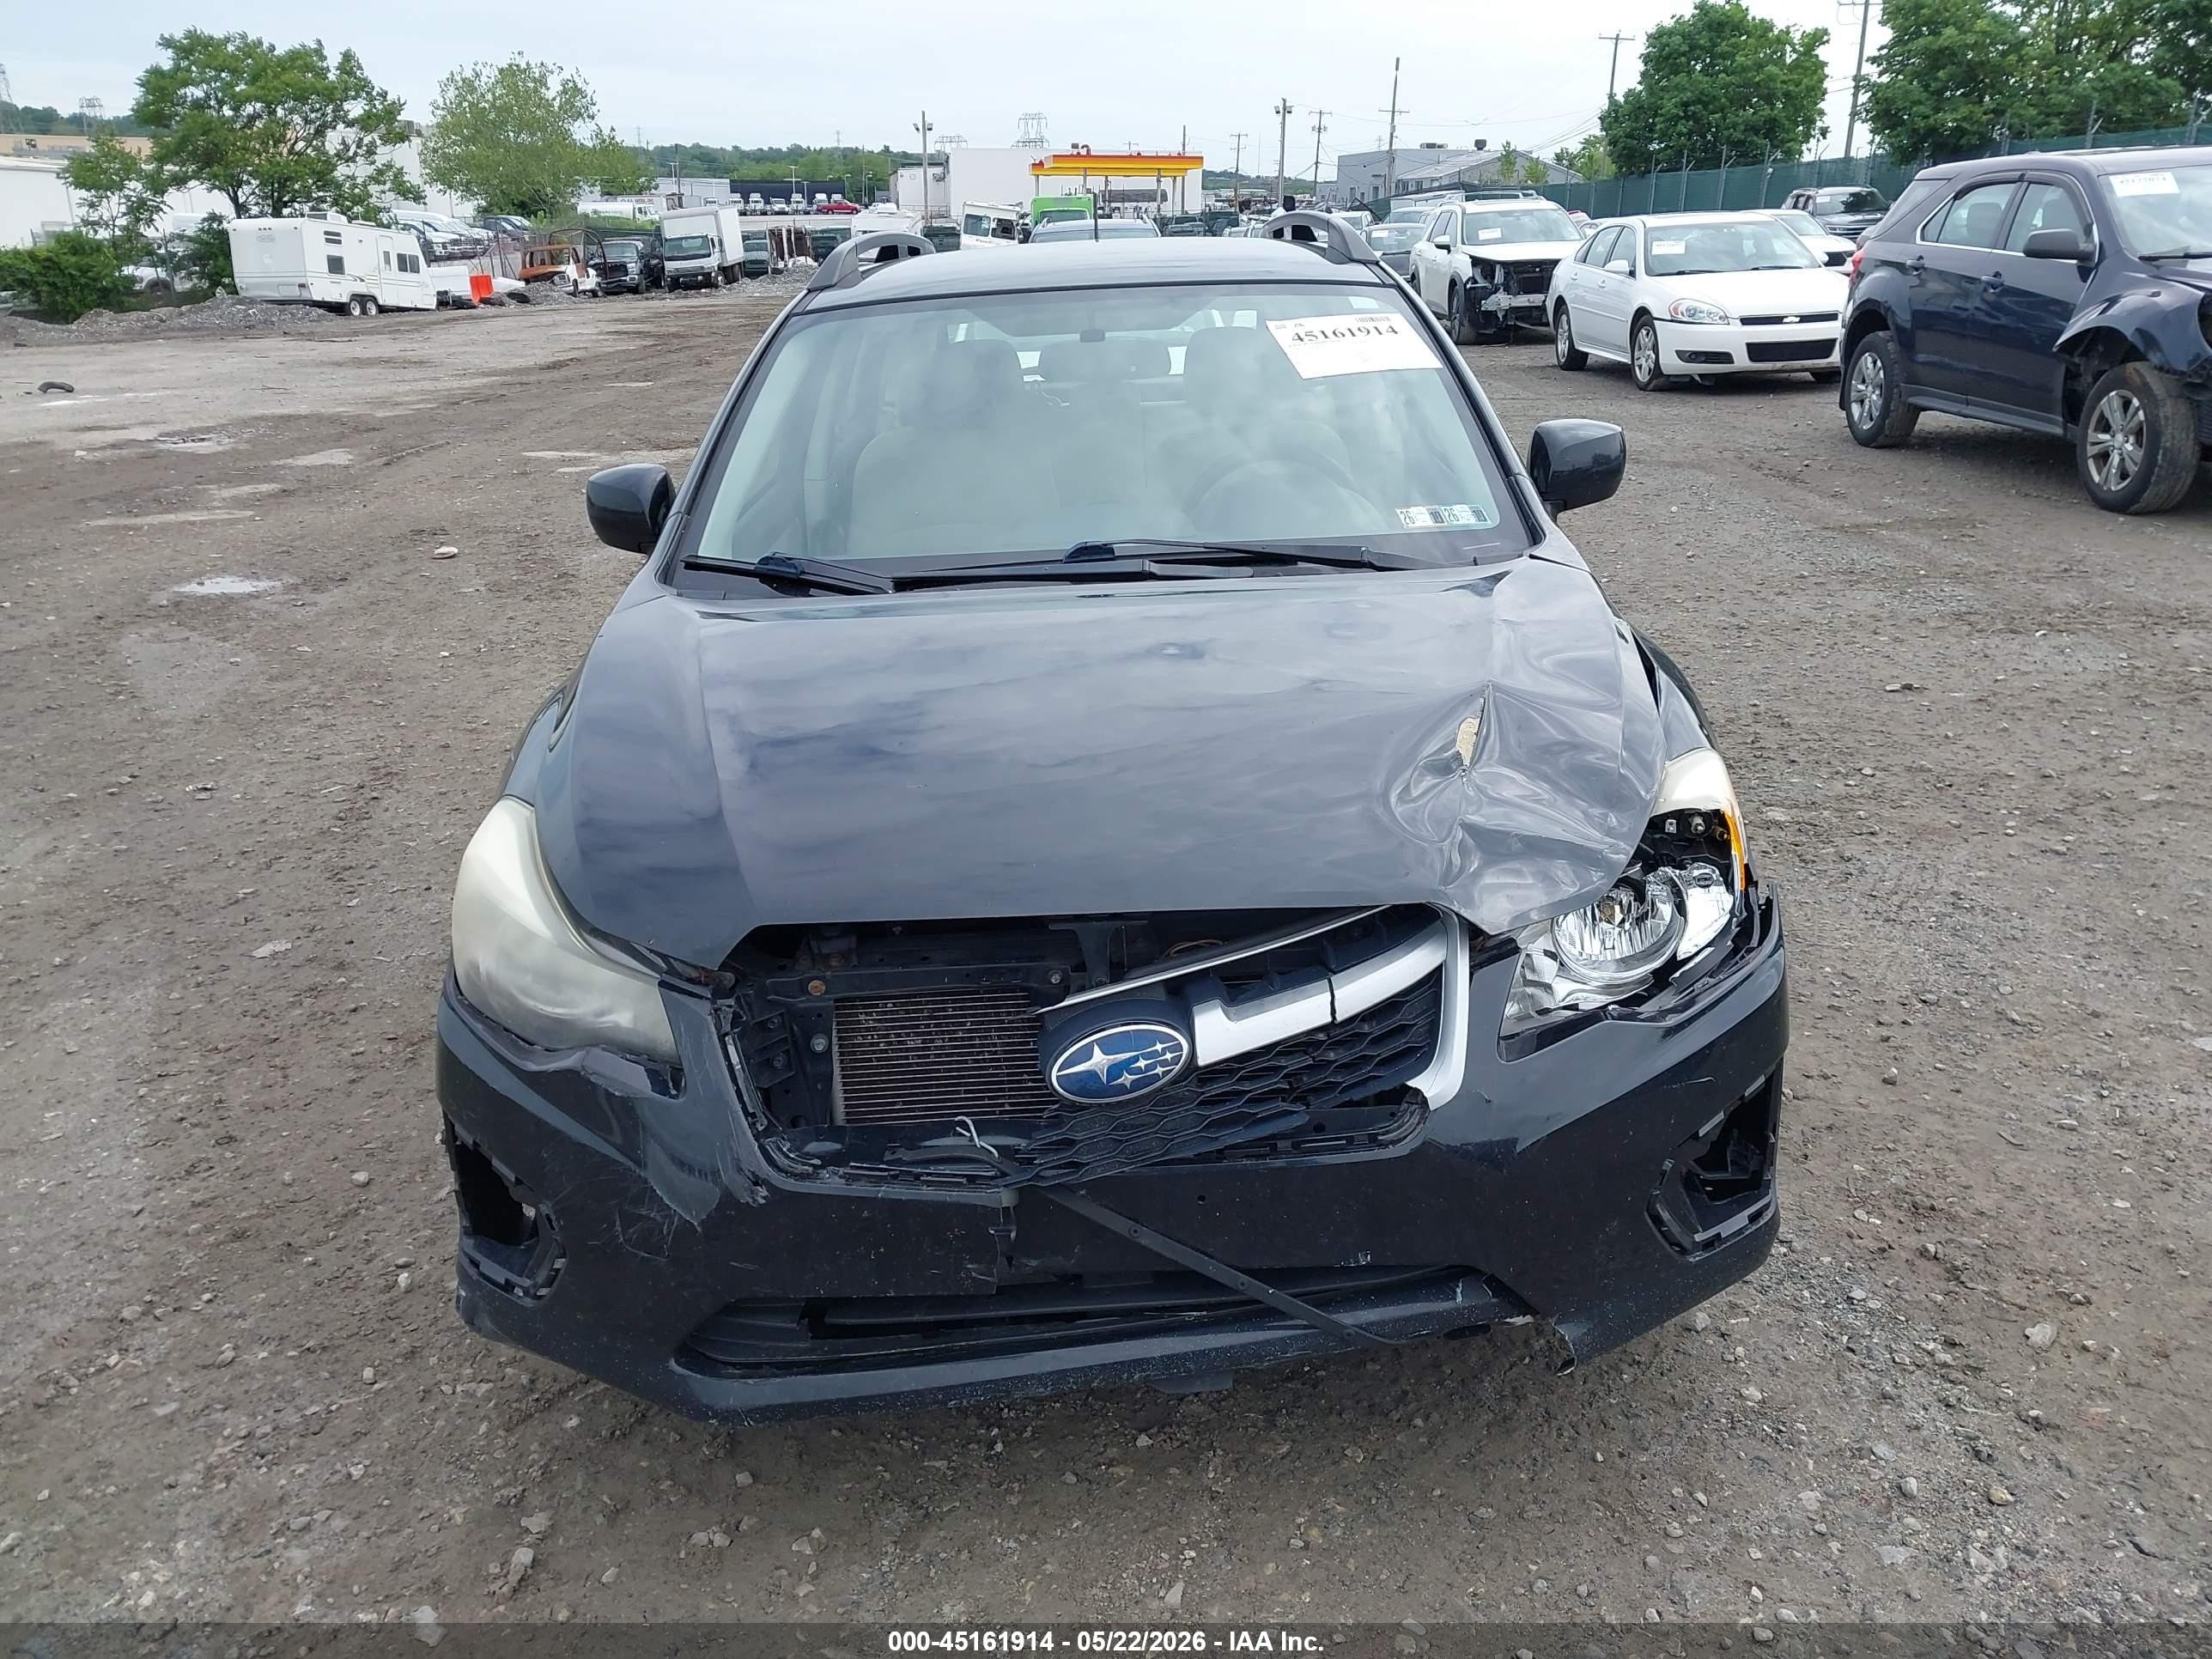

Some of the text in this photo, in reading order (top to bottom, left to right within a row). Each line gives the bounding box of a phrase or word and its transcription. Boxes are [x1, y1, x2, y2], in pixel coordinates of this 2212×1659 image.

[1291, 325, 1399, 343] 45161914
[1400, 510, 1416, 526] 26
[1443, 507, 1460, 523] 26
